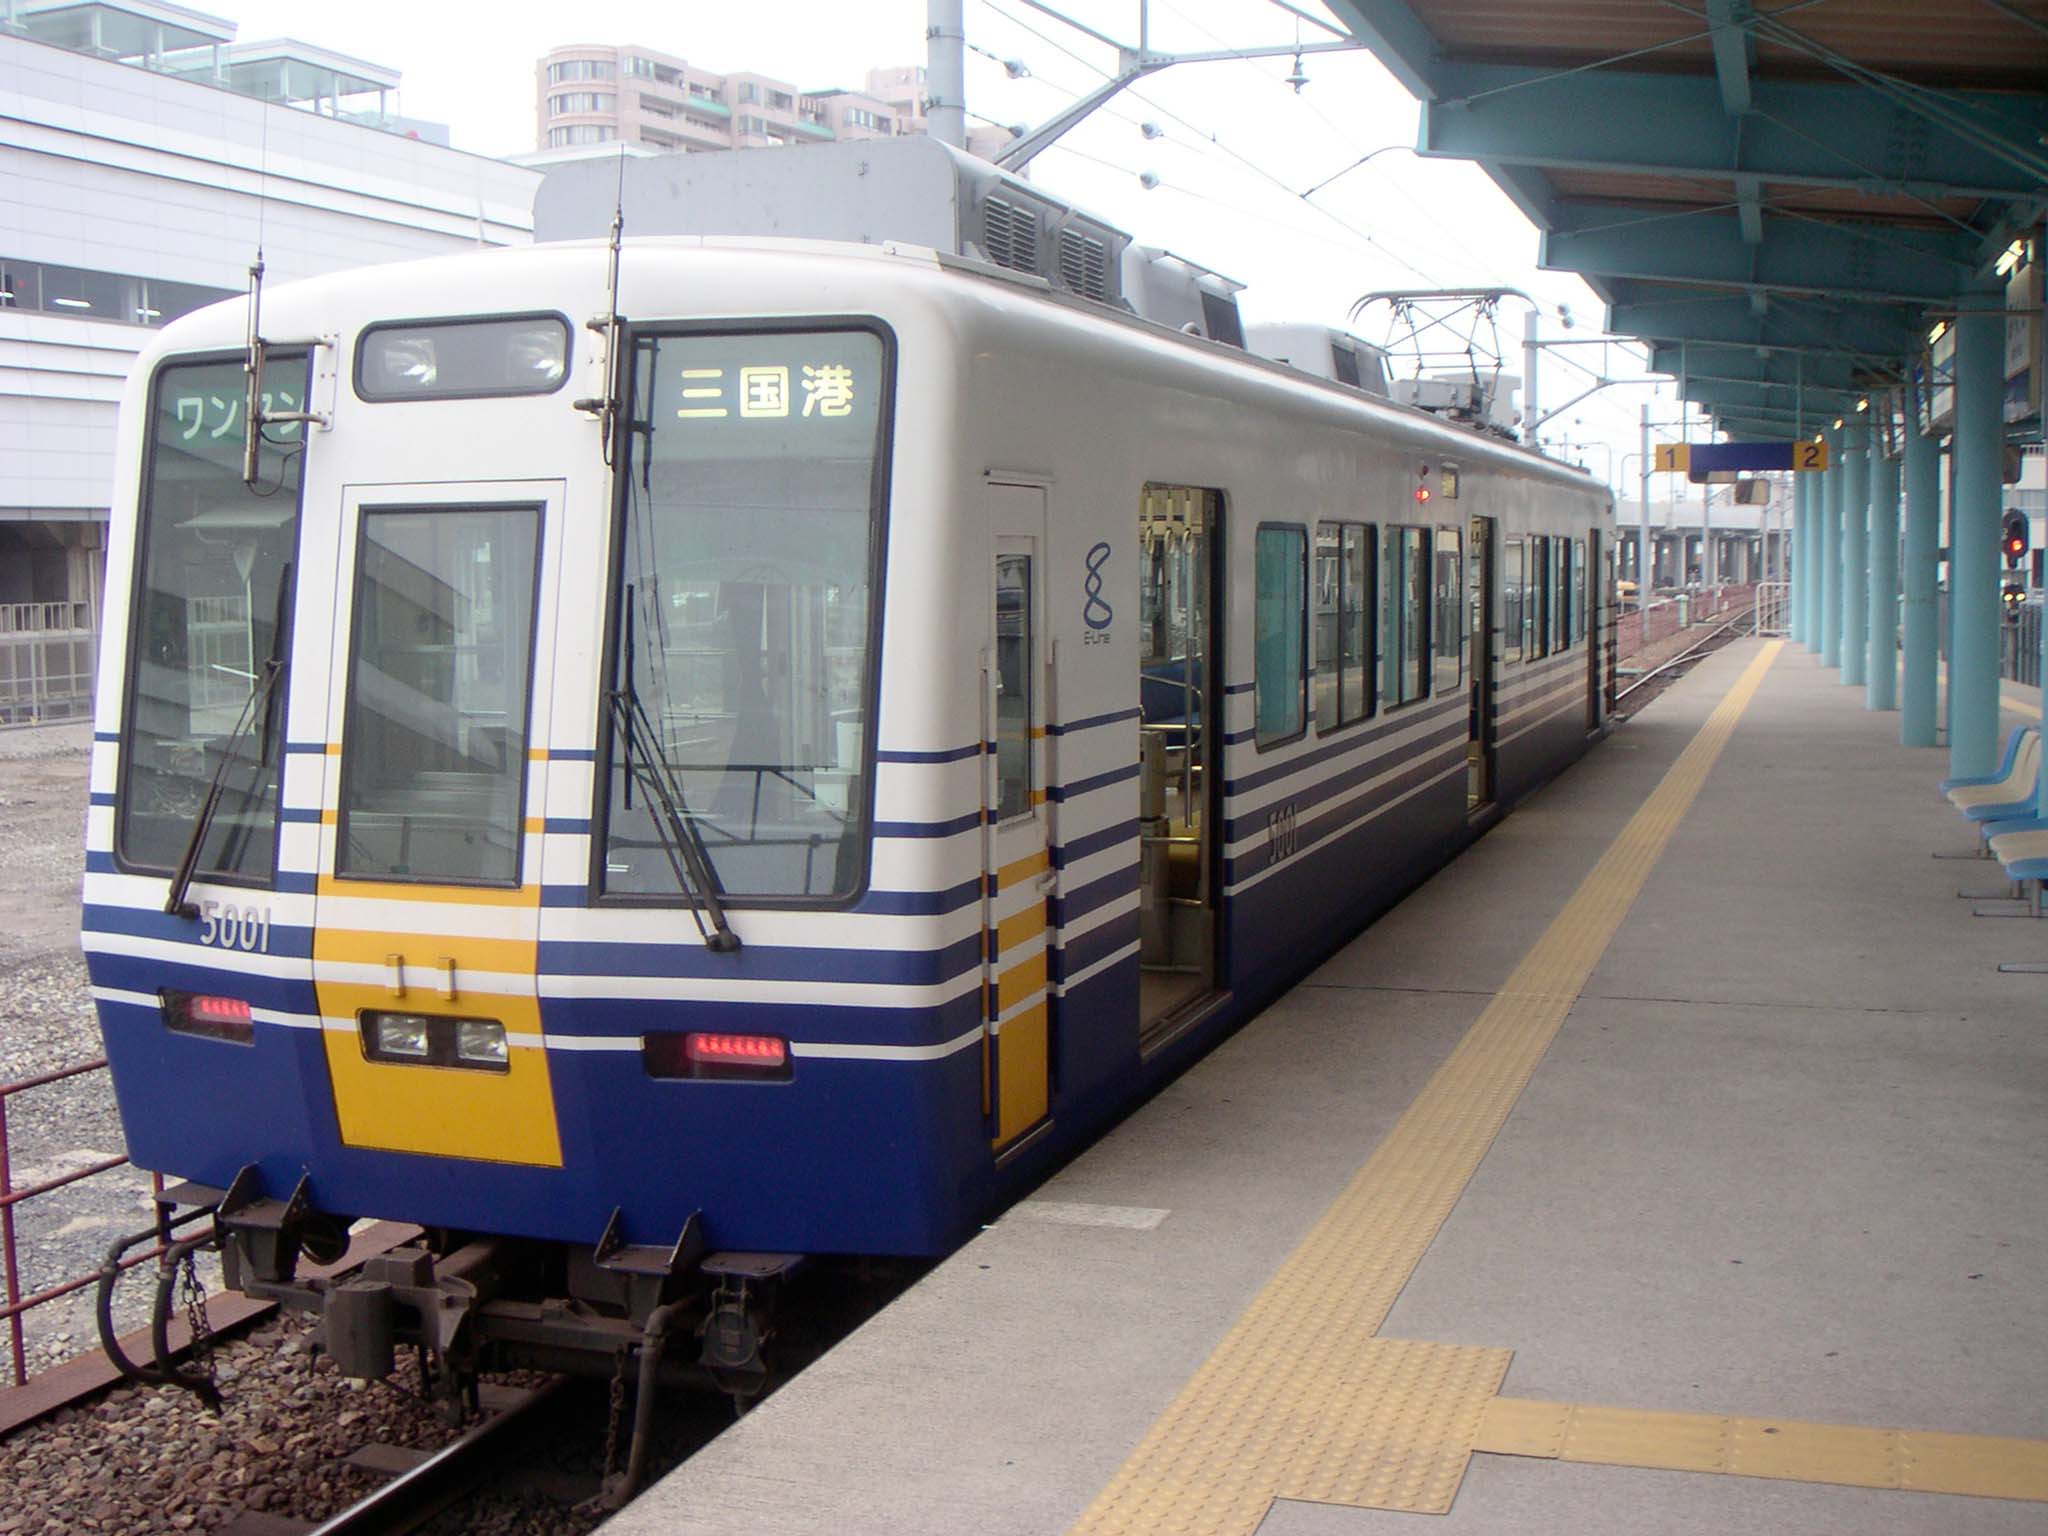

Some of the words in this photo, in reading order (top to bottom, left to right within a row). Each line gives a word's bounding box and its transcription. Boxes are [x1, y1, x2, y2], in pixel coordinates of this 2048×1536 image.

[677, 365, 854, 418] 三国港
[1664, 448, 1676, 469] 1
[1803, 446, 1819, 468] 2
[200, 900, 271, 953] 5001
